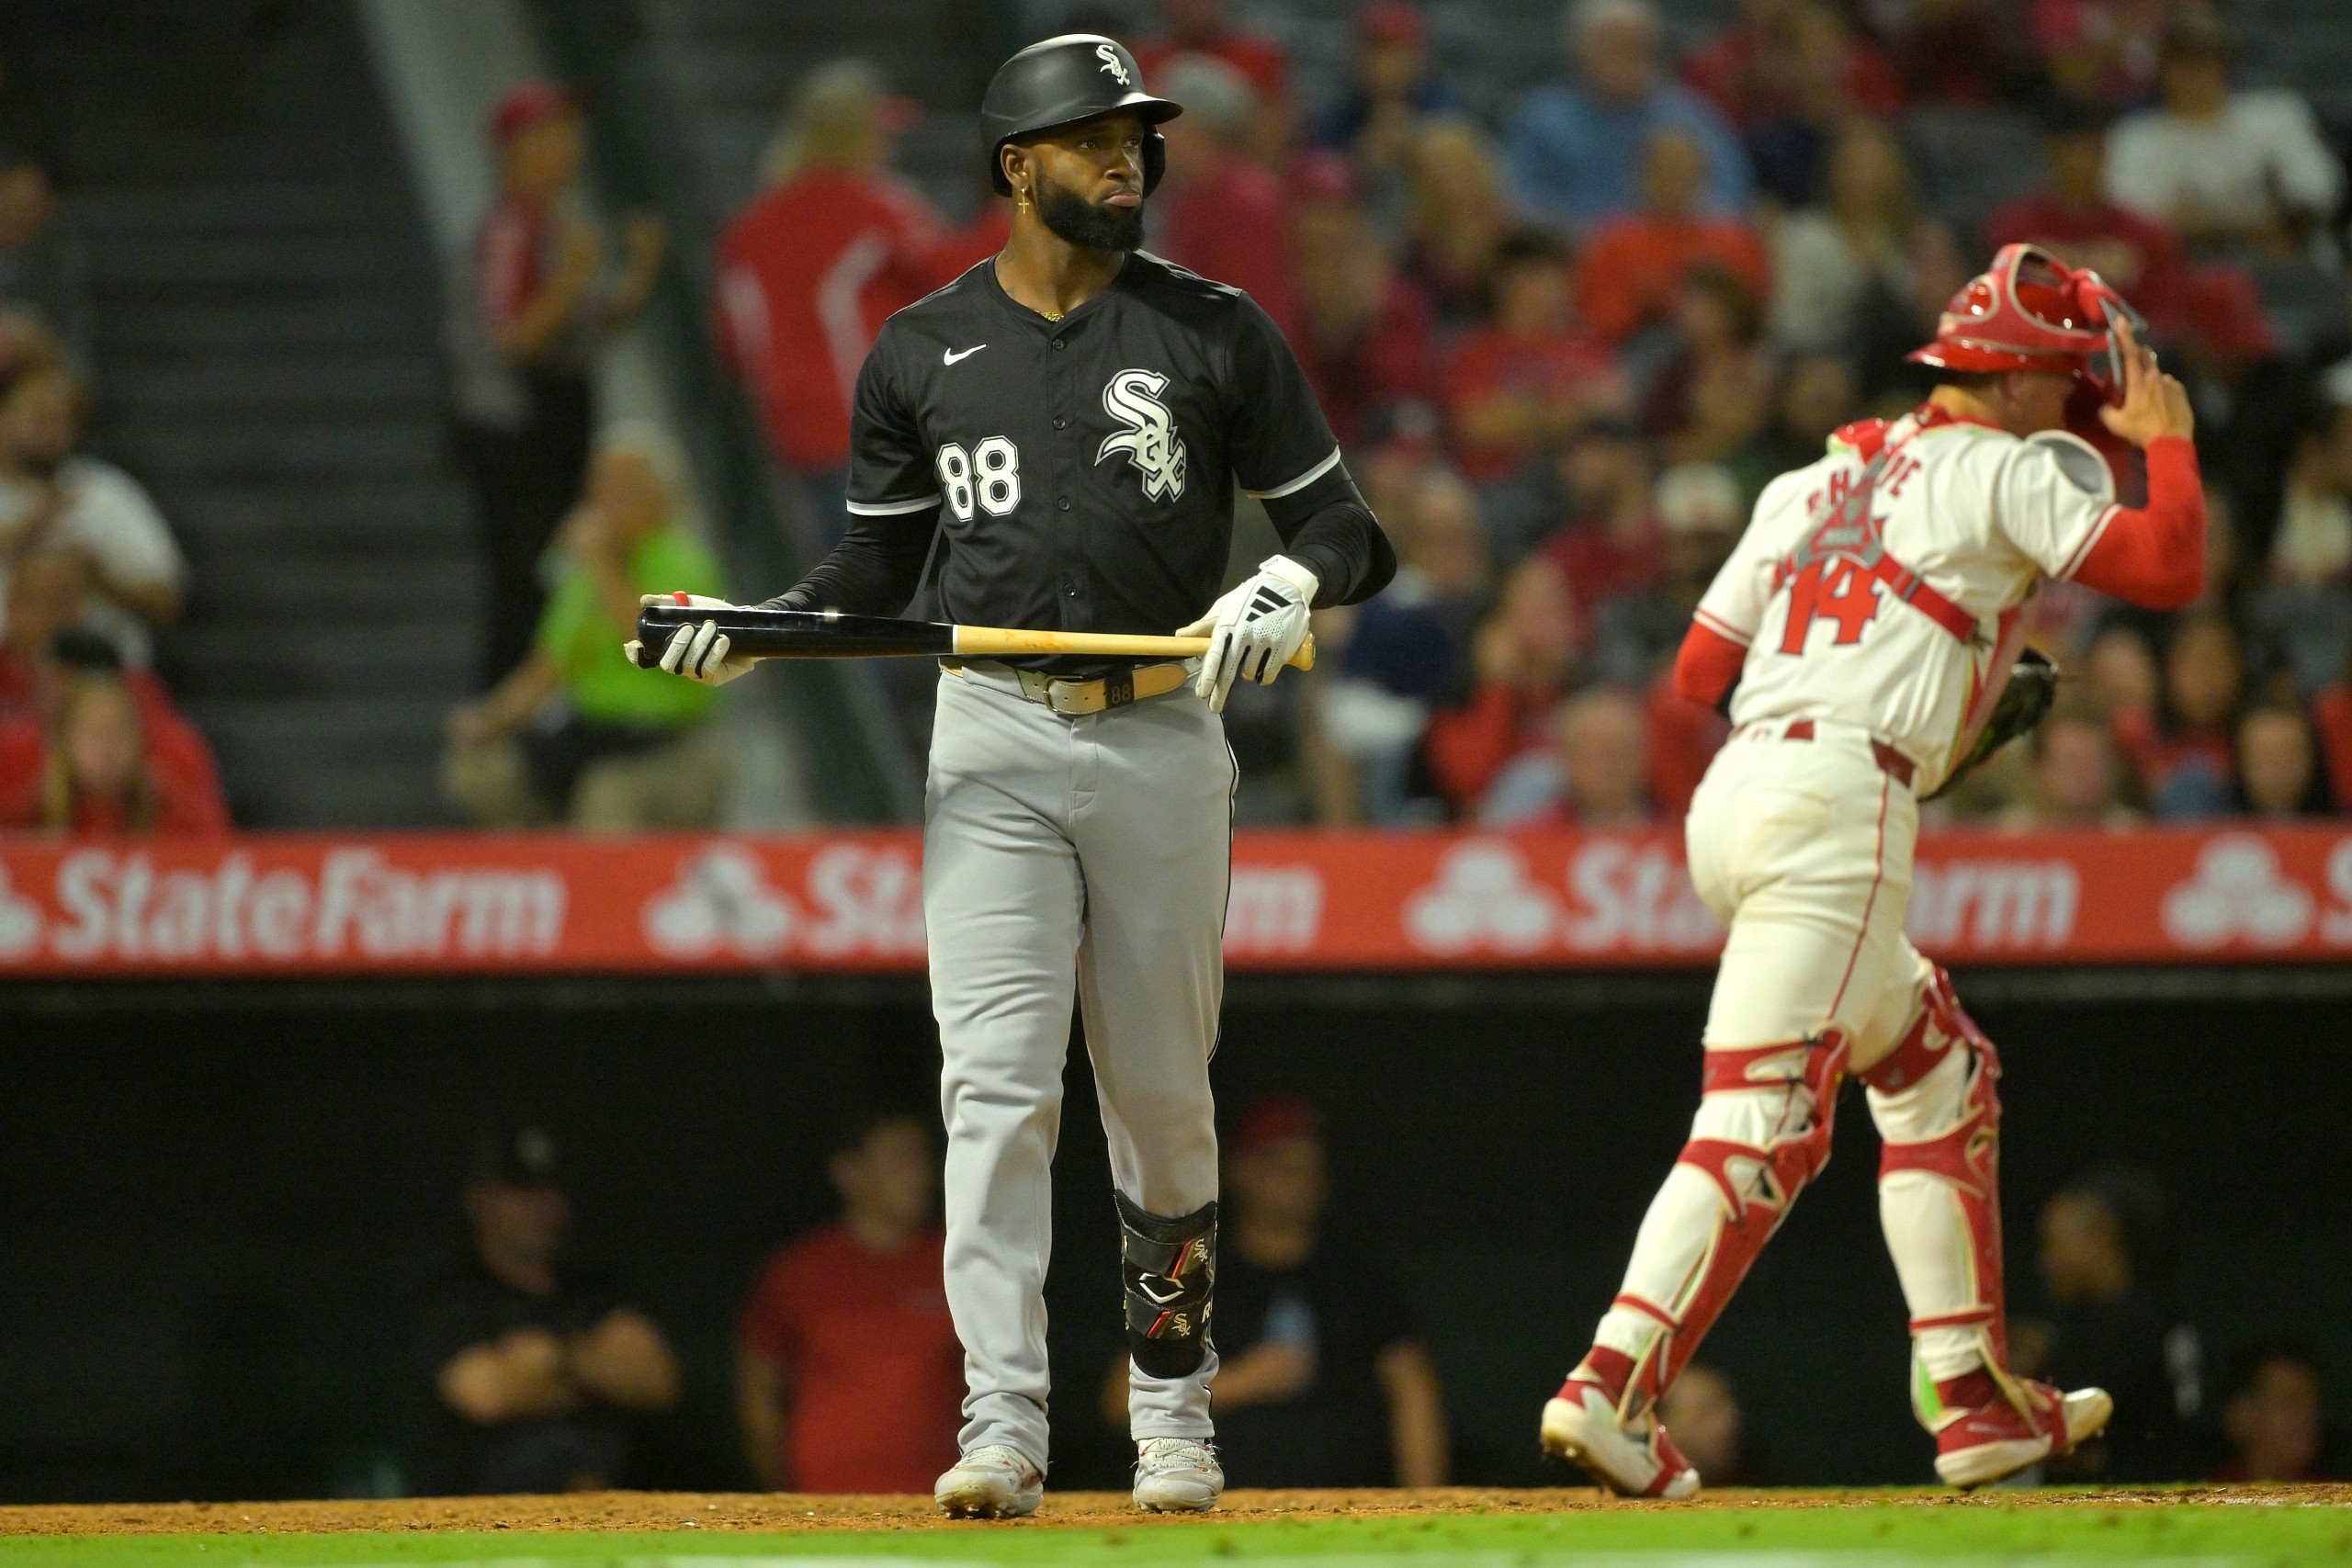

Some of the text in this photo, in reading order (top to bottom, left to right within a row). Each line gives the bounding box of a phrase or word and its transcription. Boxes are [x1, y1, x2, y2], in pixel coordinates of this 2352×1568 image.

[935, 434, 1022, 523] 88
[1094, 368, 1187, 503] Sox
[1771, 517, 1888, 656] 14
[1111, 684, 1132, 705] 88
